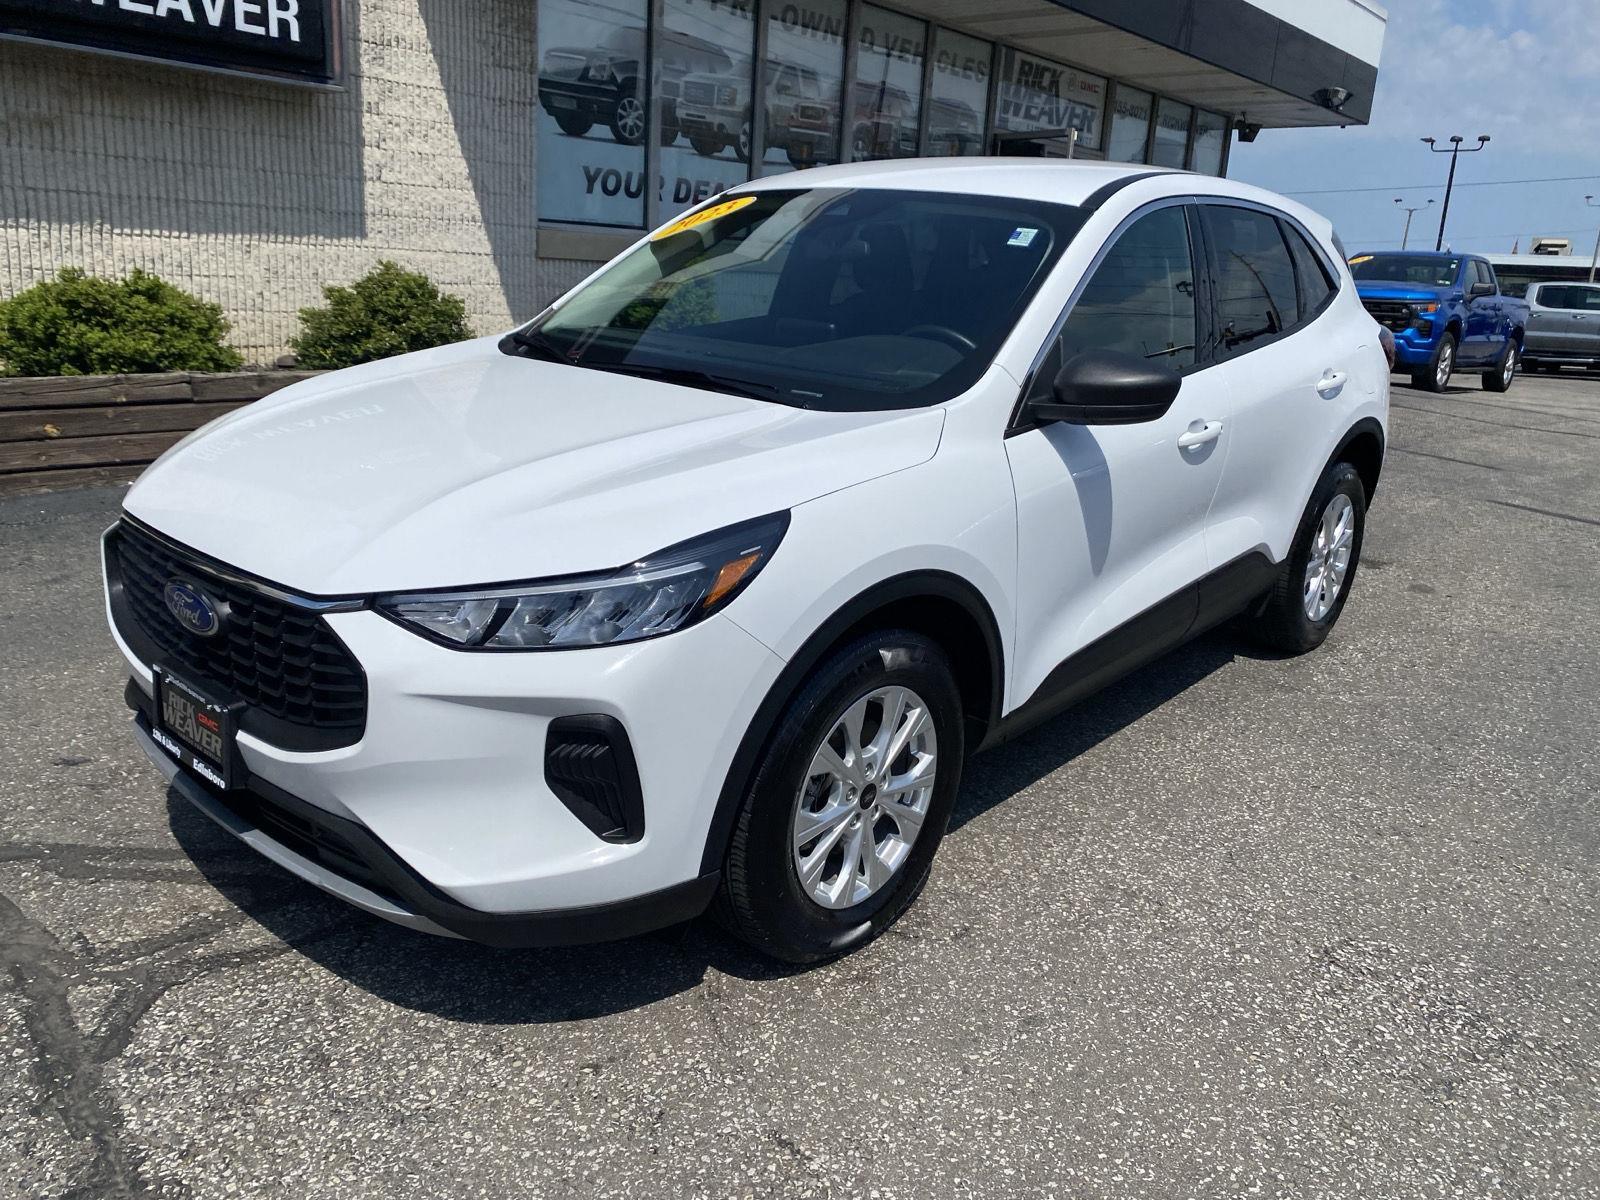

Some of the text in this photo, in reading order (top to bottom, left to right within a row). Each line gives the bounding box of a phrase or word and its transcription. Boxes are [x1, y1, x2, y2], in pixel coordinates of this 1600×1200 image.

[173, 589, 202, 627] Ford
[168, 691, 195, 720] RICK
[163, 702, 223, 757] WEAVER
